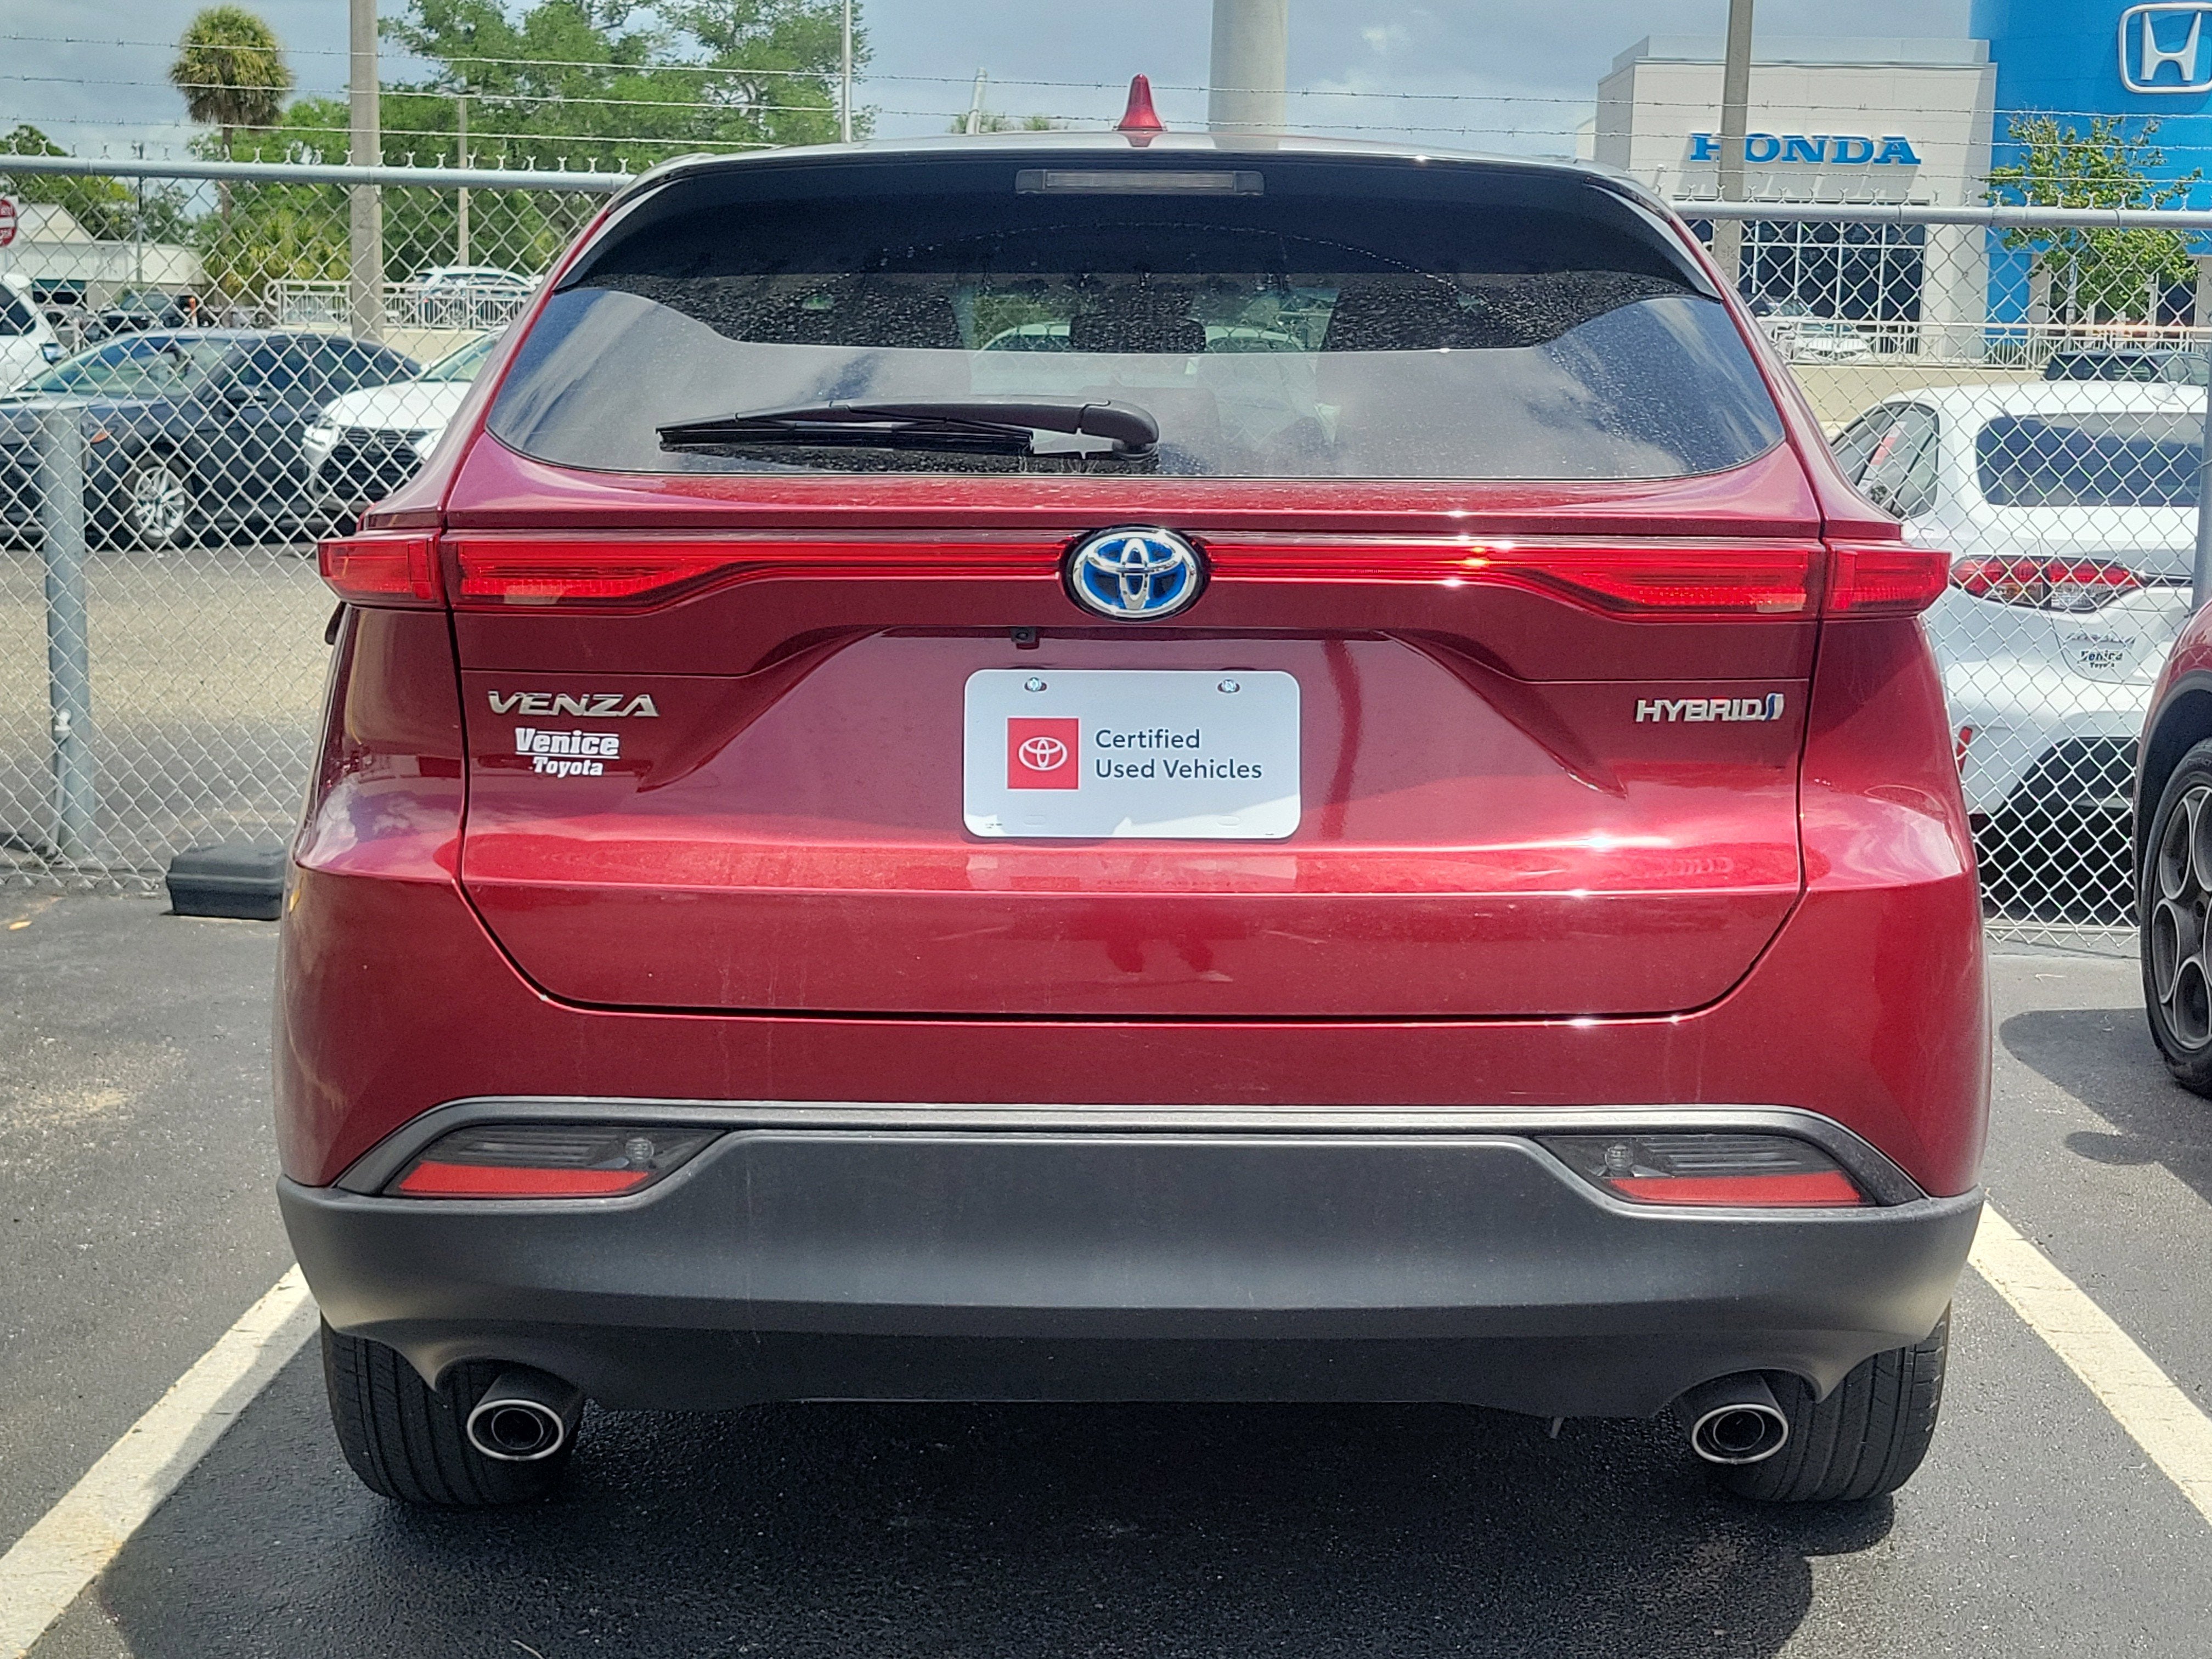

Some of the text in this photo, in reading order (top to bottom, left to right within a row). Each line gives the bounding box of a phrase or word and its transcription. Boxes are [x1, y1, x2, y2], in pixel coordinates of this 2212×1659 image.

[1689, 133, 1921, 165] HONDA
[488, 690, 659, 717] VENZA
[1635, 699, 1763, 723] HYBRID
[514, 727, 620, 756] Venice
[1096, 728, 1200, 749] Certified
[532, 757, 603, 778] Toyota
[1096, 758, 1262, 779] Used Vehicles
